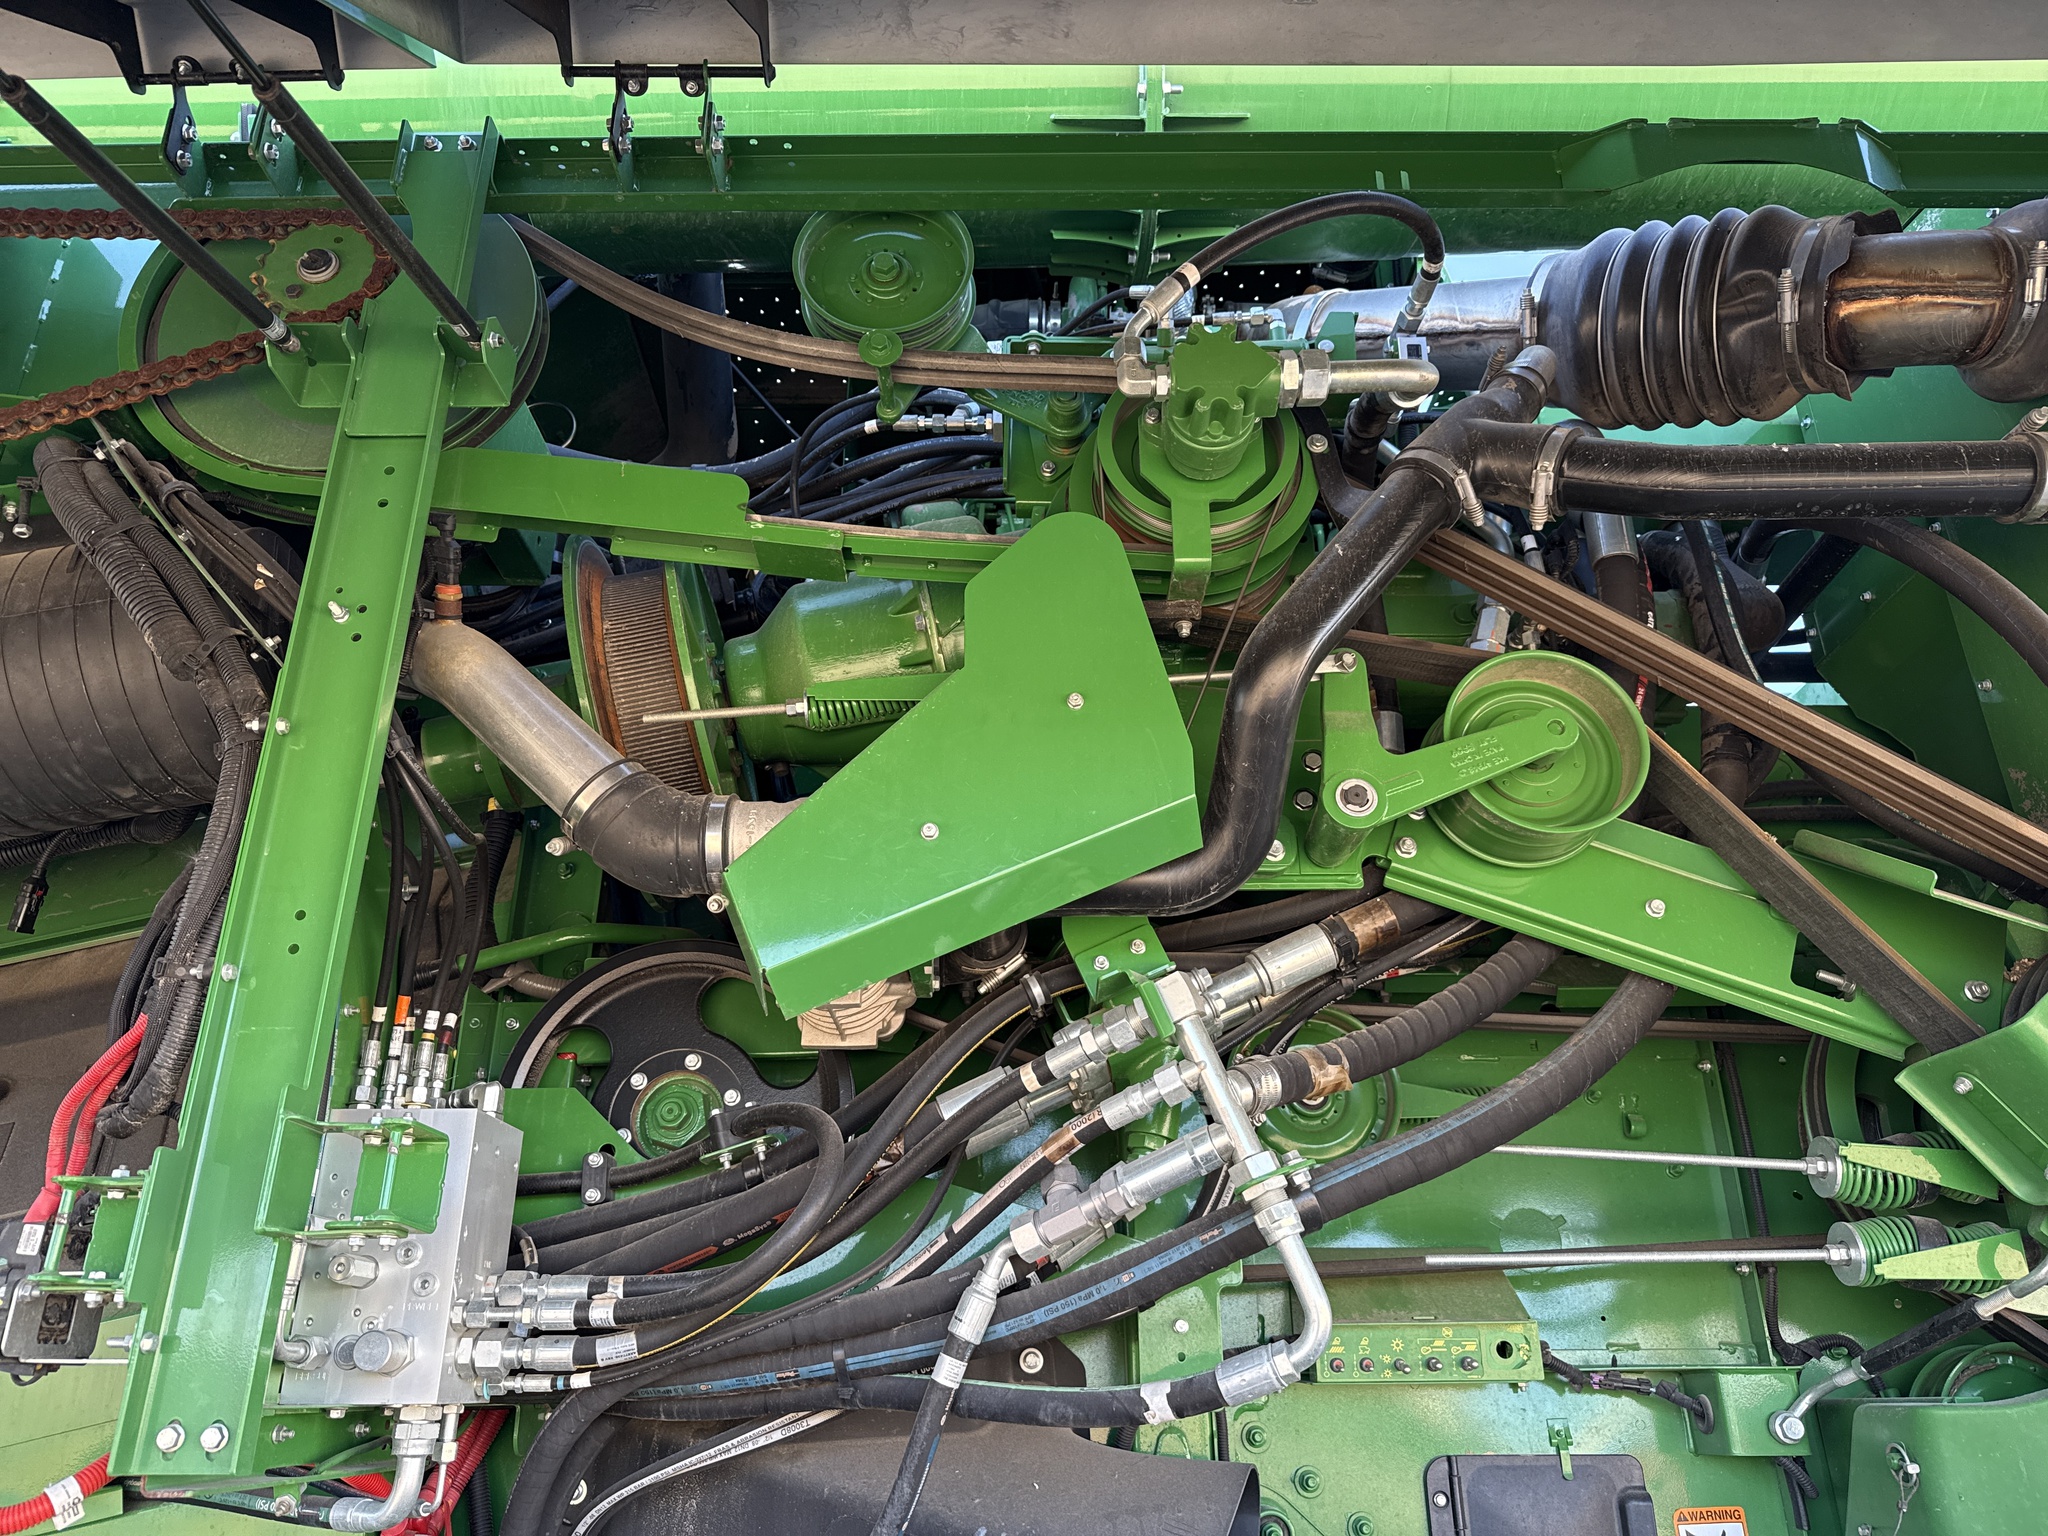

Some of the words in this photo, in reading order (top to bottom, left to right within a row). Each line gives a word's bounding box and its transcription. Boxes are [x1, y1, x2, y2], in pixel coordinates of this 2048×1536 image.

[1223, 1184, 1234, 1199] MAX
[1076, 1288, 1095, 1303] MPa
[1092, 1282, 1108, 1296] 1,0
[1058, 1295, 1078, 1312] (150
[1041, 1303, 1060, 1319] PSI)
[639, 1387, 656, 1397] (150
[656, 1386, 672, 1396] MPa
[778, 1417, 811, 1437] T3008D
[732, 1441, 750, 1453] DN12
[750, 1438, 761, 1447] -08
[593, 1503, 607, 1515] DN12
[605, 1496, 617, 1505] MAX
[616, 1491, 625, 1499] WP
[632, 1481, 645, 1490] BAR
[671, 1462, 687, 1472] MSHA
[713, 1444, 730, 1454] FRAS
[735, 1426, 767, 1446] ABRASION
[766, 1411, 800, 1431] RESISTANT
[1687, 1509, 1741, 1521] WARNING
